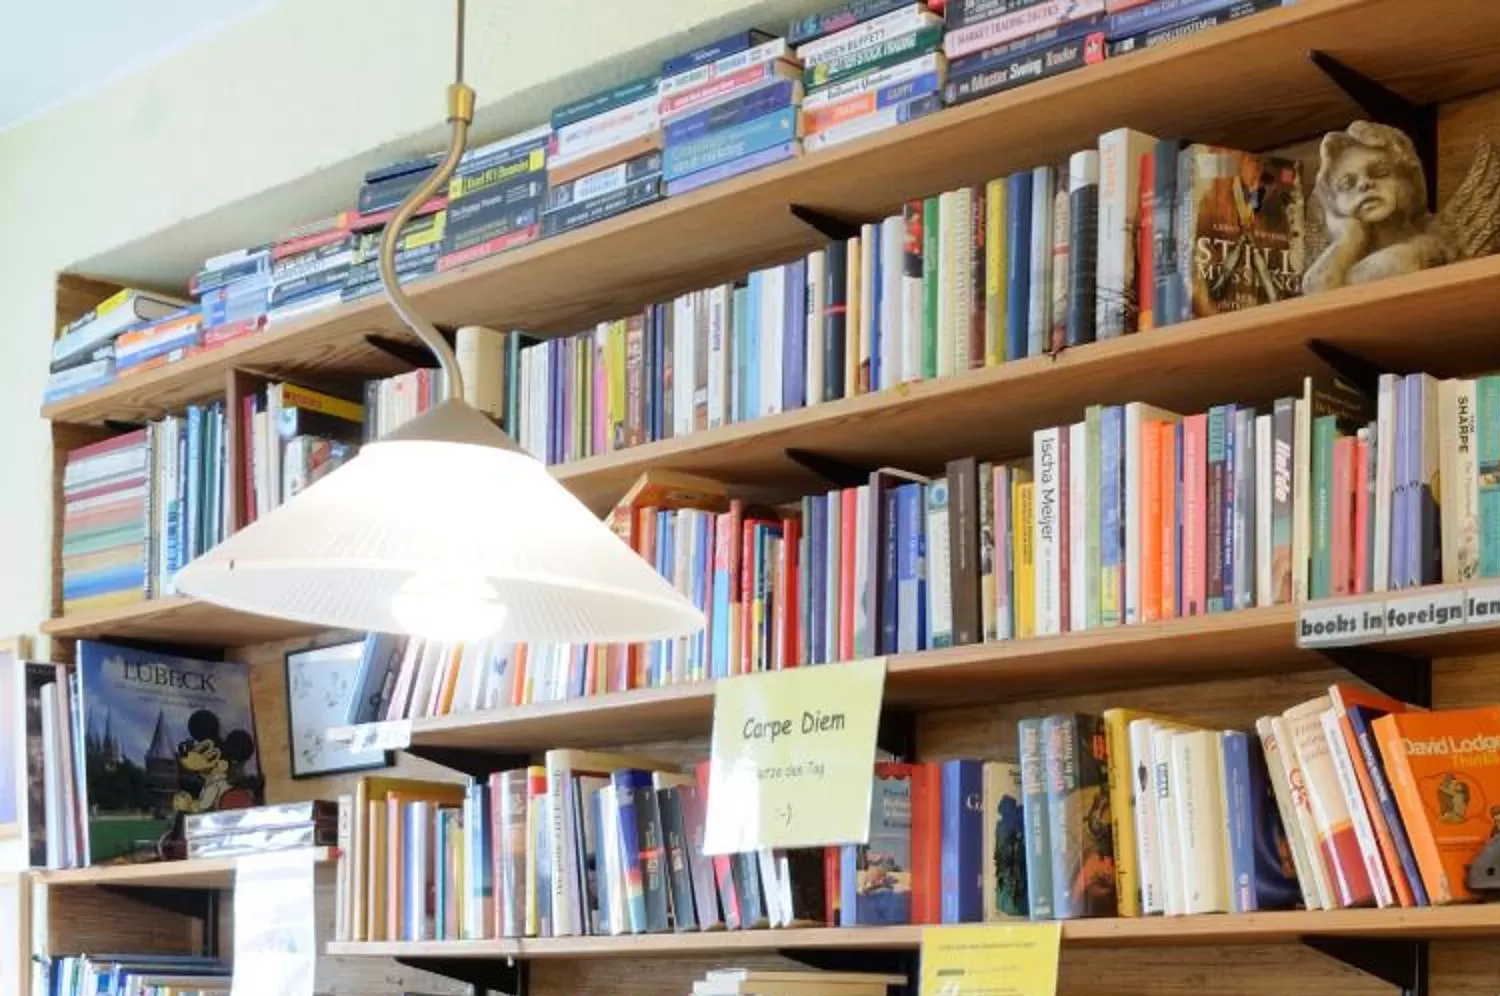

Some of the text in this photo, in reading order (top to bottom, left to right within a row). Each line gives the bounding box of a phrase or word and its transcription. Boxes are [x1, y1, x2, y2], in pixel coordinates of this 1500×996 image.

[1457, 396, 1468, 453] SHARPE
[1301, 614, 1357, 637] books
[1363, 612, 1384, 630] in
[1388, 603, 1462, 628] foreign
[743, 711, 846, 743] Carpe Diem
[1402, 735, 1449, 757] David
